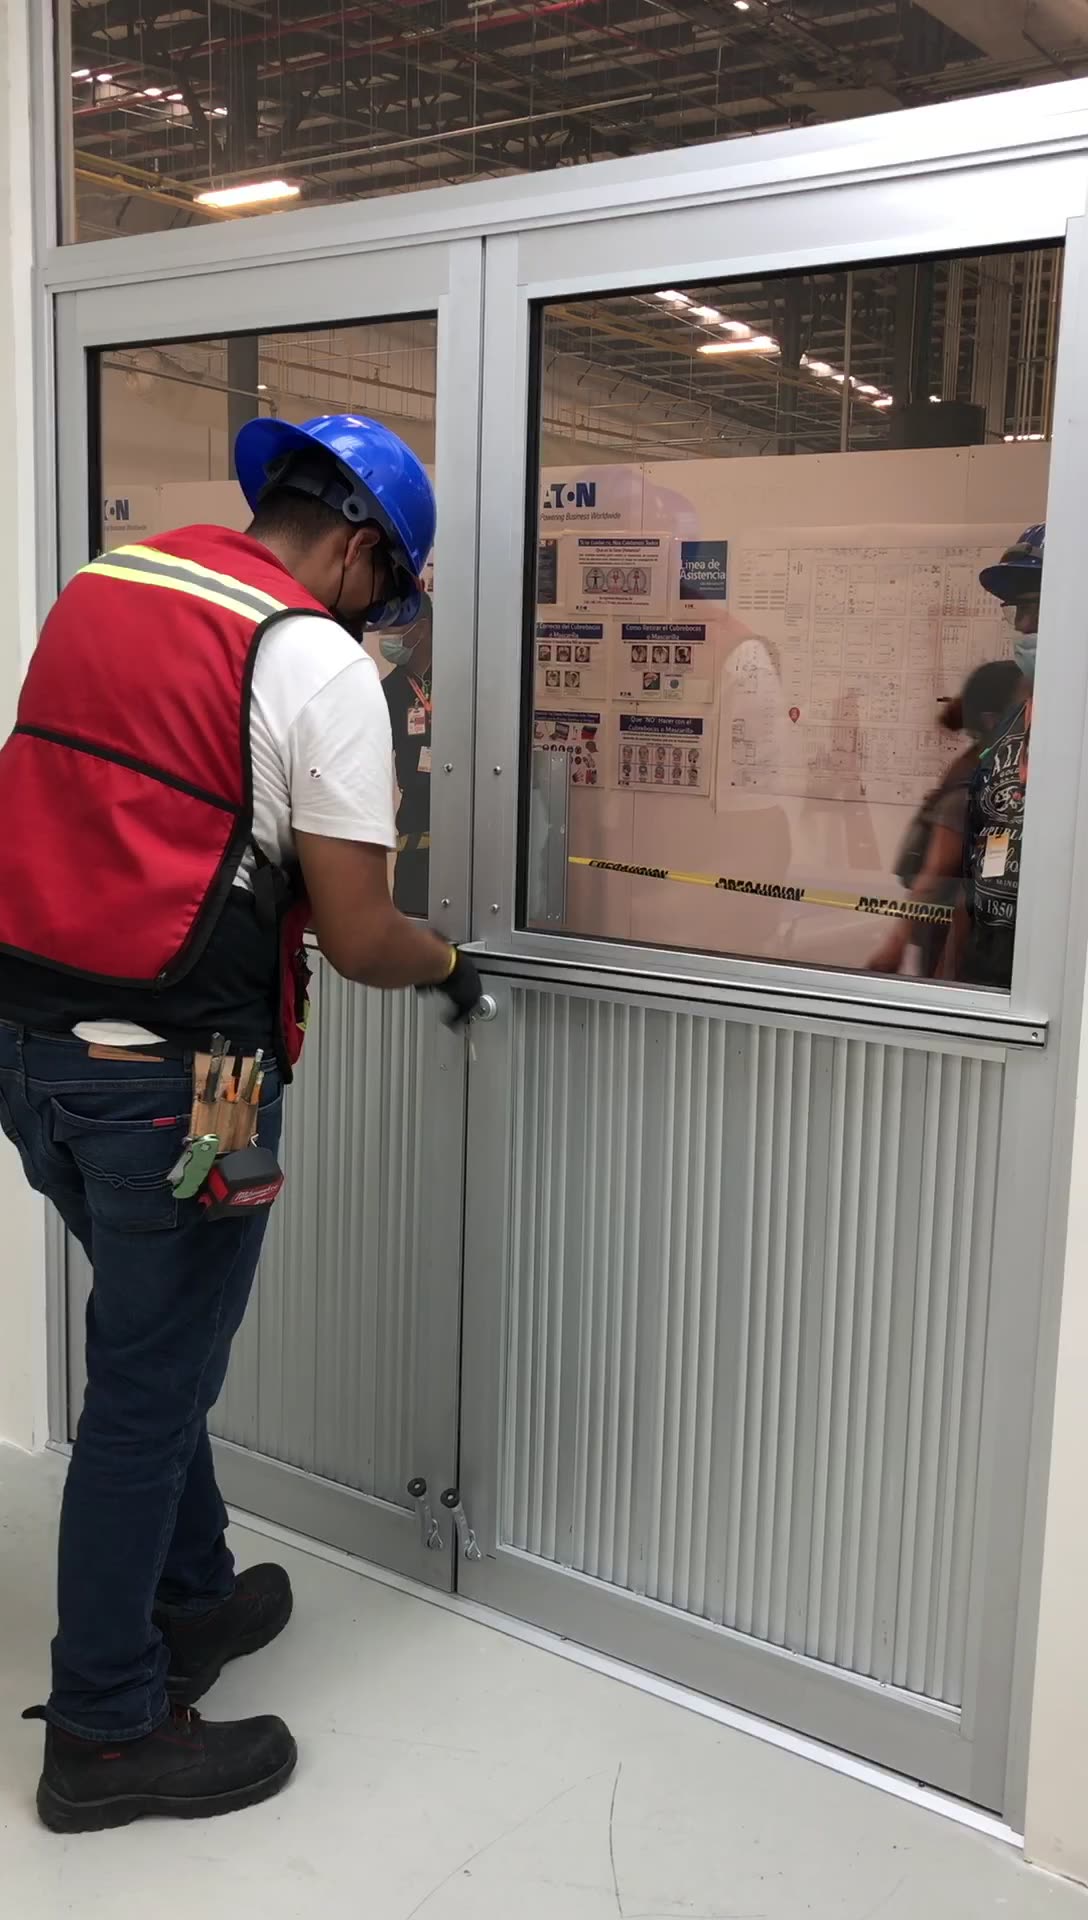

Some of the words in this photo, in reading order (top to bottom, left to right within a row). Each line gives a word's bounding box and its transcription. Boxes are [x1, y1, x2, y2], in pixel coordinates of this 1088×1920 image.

[566, 512, 589, 521] Business
[590, 511, 621, 520] Worldwide
[707, 558, 720, 570] de
[680, 569, 726, 580] Asistencia
[669, 624, 702, 632] Cubrebocas
[665, 726, 695, 734] Mascarilla
[987, 899, 1014, 919] 1850
